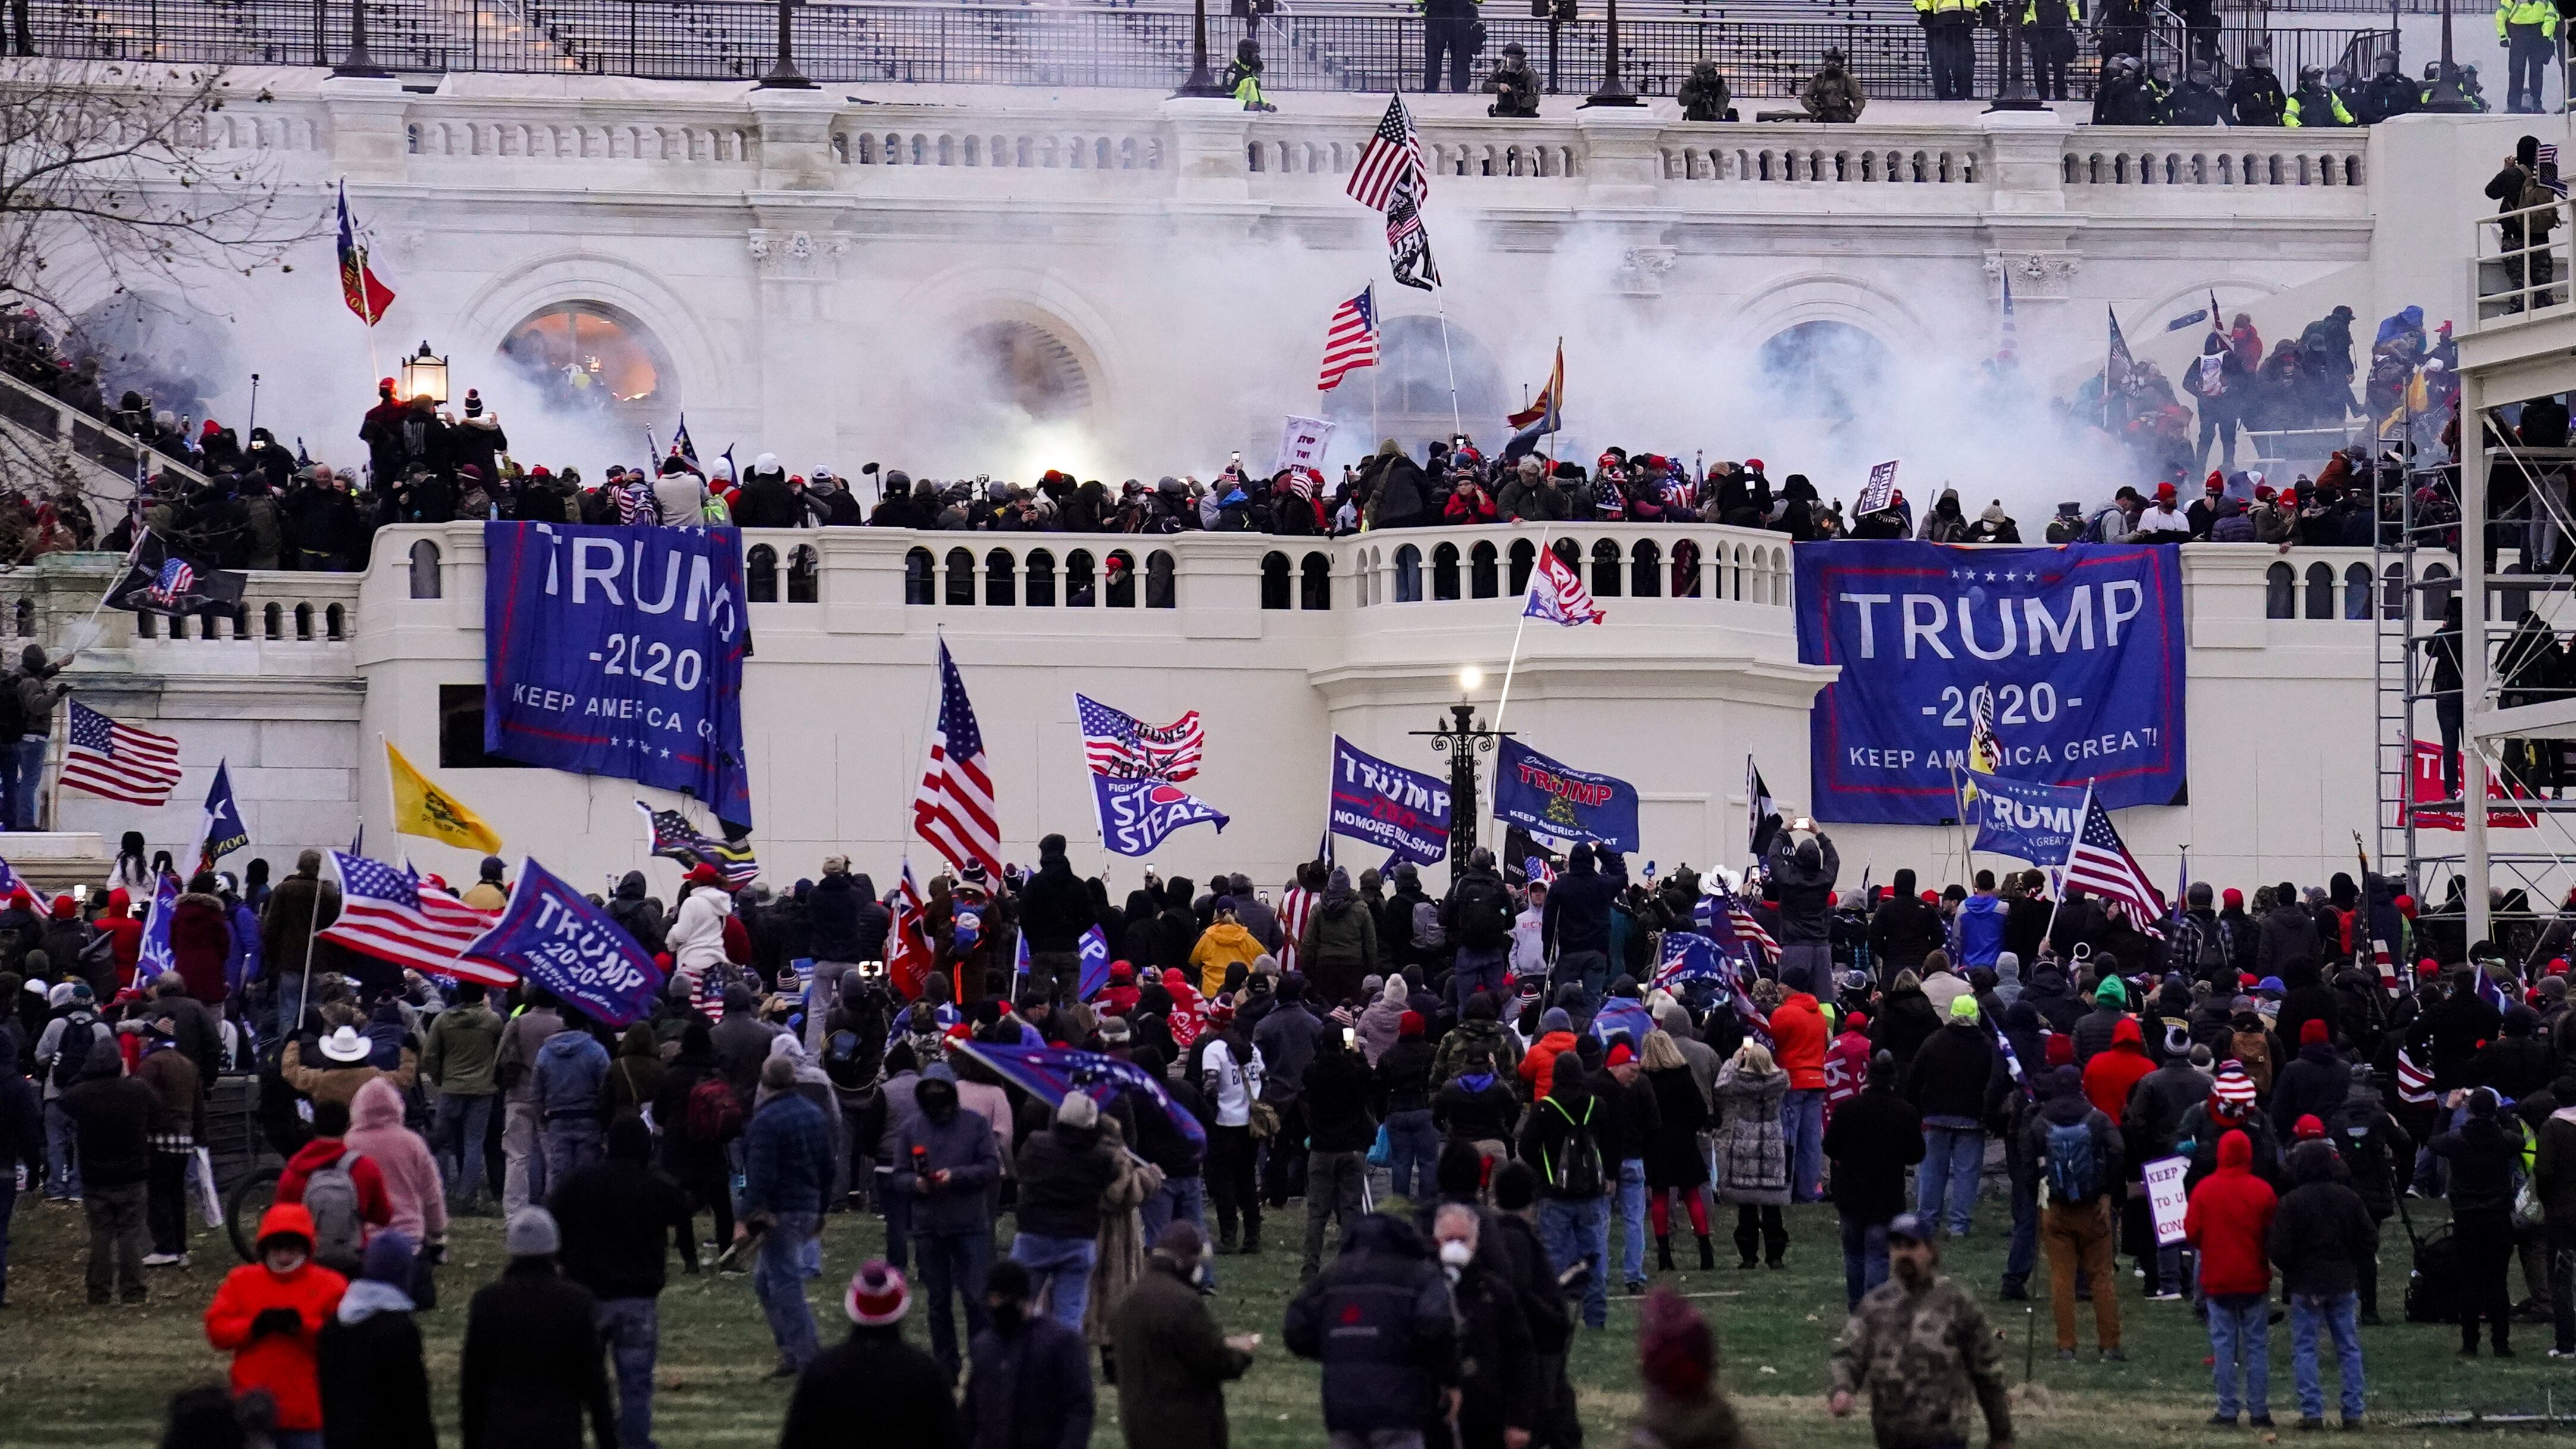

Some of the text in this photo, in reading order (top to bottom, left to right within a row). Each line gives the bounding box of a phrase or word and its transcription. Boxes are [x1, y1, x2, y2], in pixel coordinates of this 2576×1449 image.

[1874, 464, 1894, 507] TRUMP
[537, 523, 736, 643] TRUM
[1840, 579, 2143, 661] TRUMP
[512, 683, 576, 711] KEEP
[584, 697, 683, 733] AMECA
[1850, 727, 2158, 769] KEEP AMICA GREAT!
[1108, 782, 1139, 792] FIGHT
[1341, 751, 1450, 817] TRUMP
[1518, 763, 1612, 807] TRUMP
[1117, 803, 1212, 853] STEAL
[1335, 810, 1355, 825] NO
[1356, 815, 1395, 838] MORE
[1509, 810, 1536, 823] KEEP
[1538, 820, 1583, 836] AMERICA
[2036, 836, 2066, 847] GREAT
[535, 892, 645, 992] TRUMP
[1662, 969, 1696, 987] KEEP
[2148, 1166, 2178, 1183] KEEP
[2154, 1196, 2171, 1209] TO
